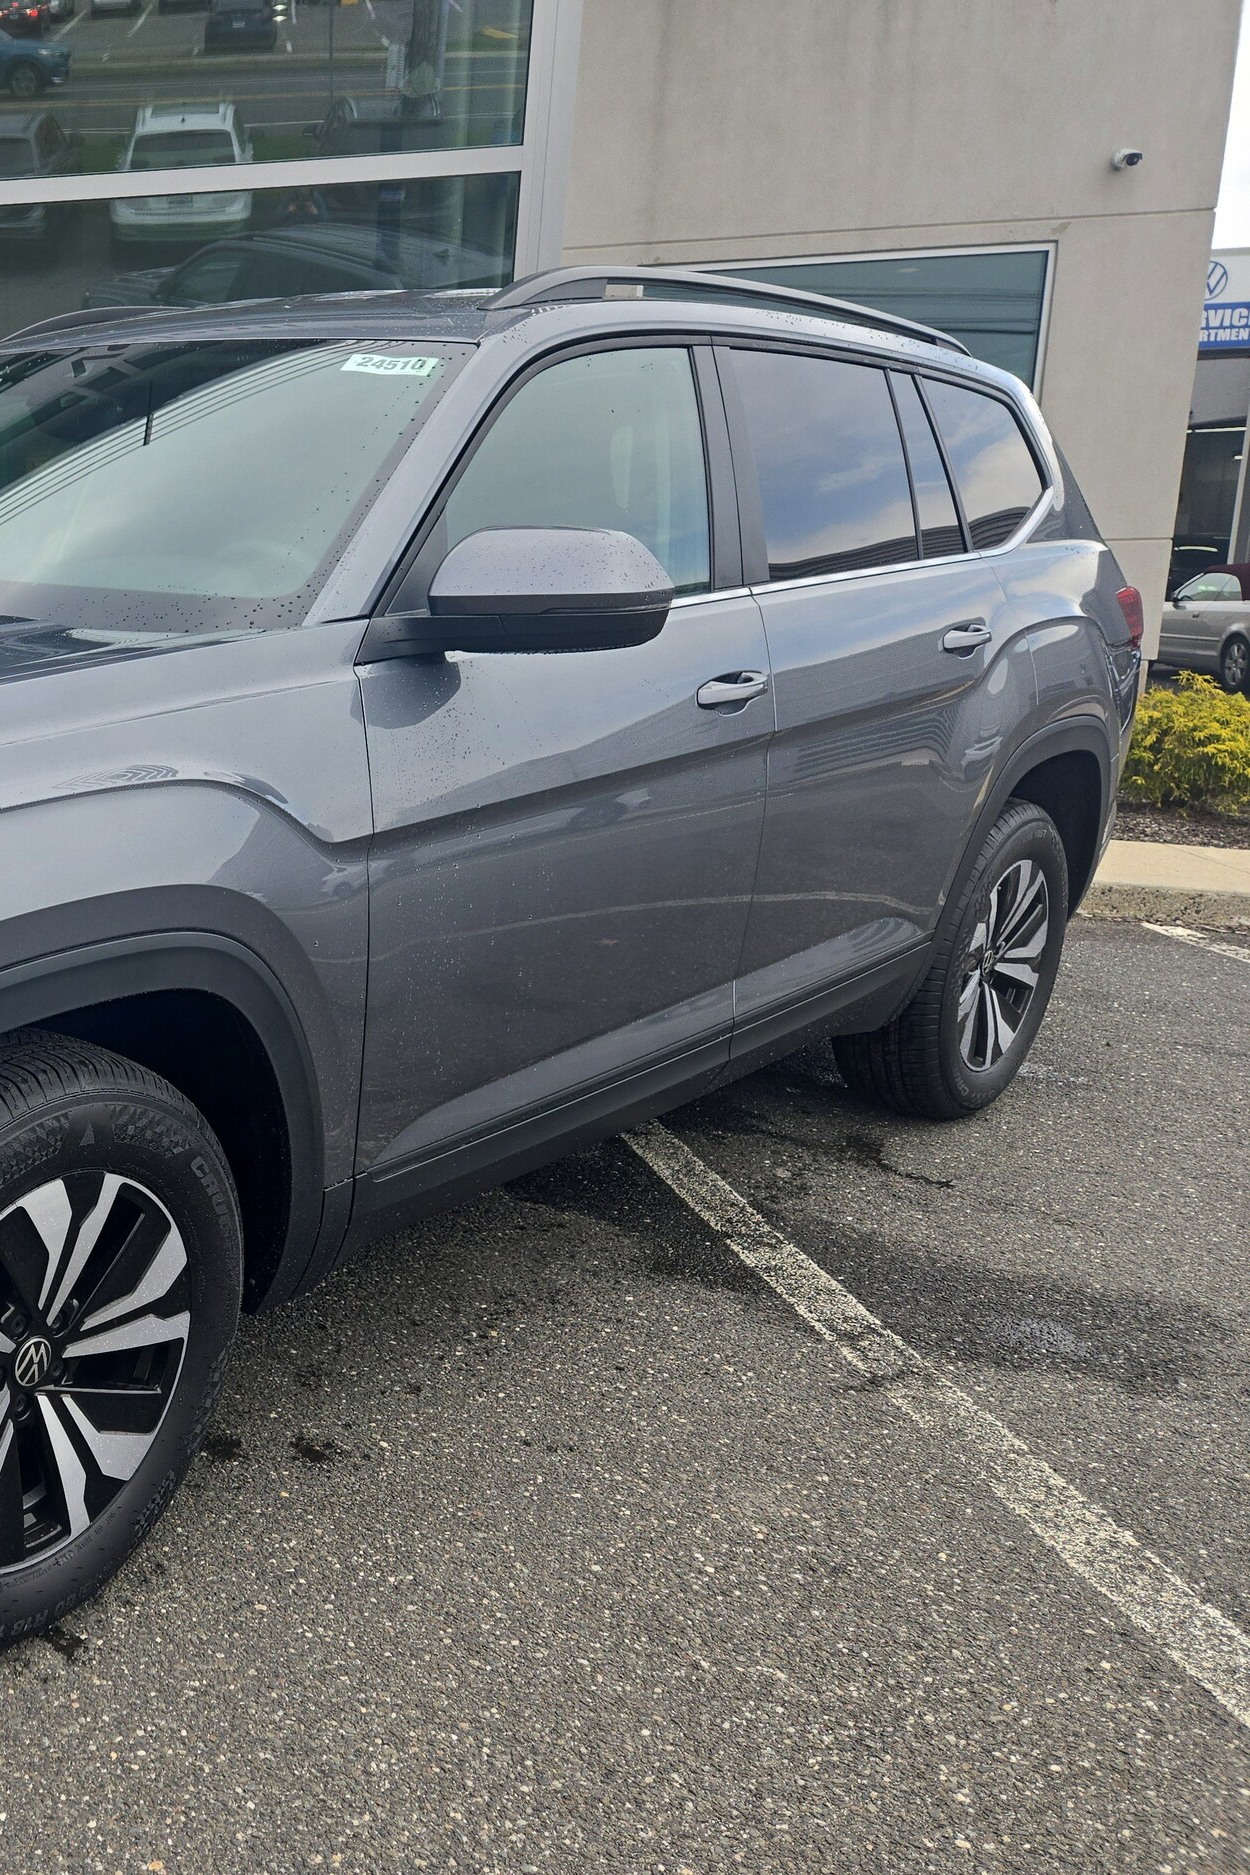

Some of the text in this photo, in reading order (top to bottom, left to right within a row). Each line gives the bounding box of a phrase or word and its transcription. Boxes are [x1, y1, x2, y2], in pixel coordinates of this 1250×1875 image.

[1198, 327, 1250, 342] RTMEN
[356, 356, 427, 370] 24510
[11, 1609, 49, 1636] R18
